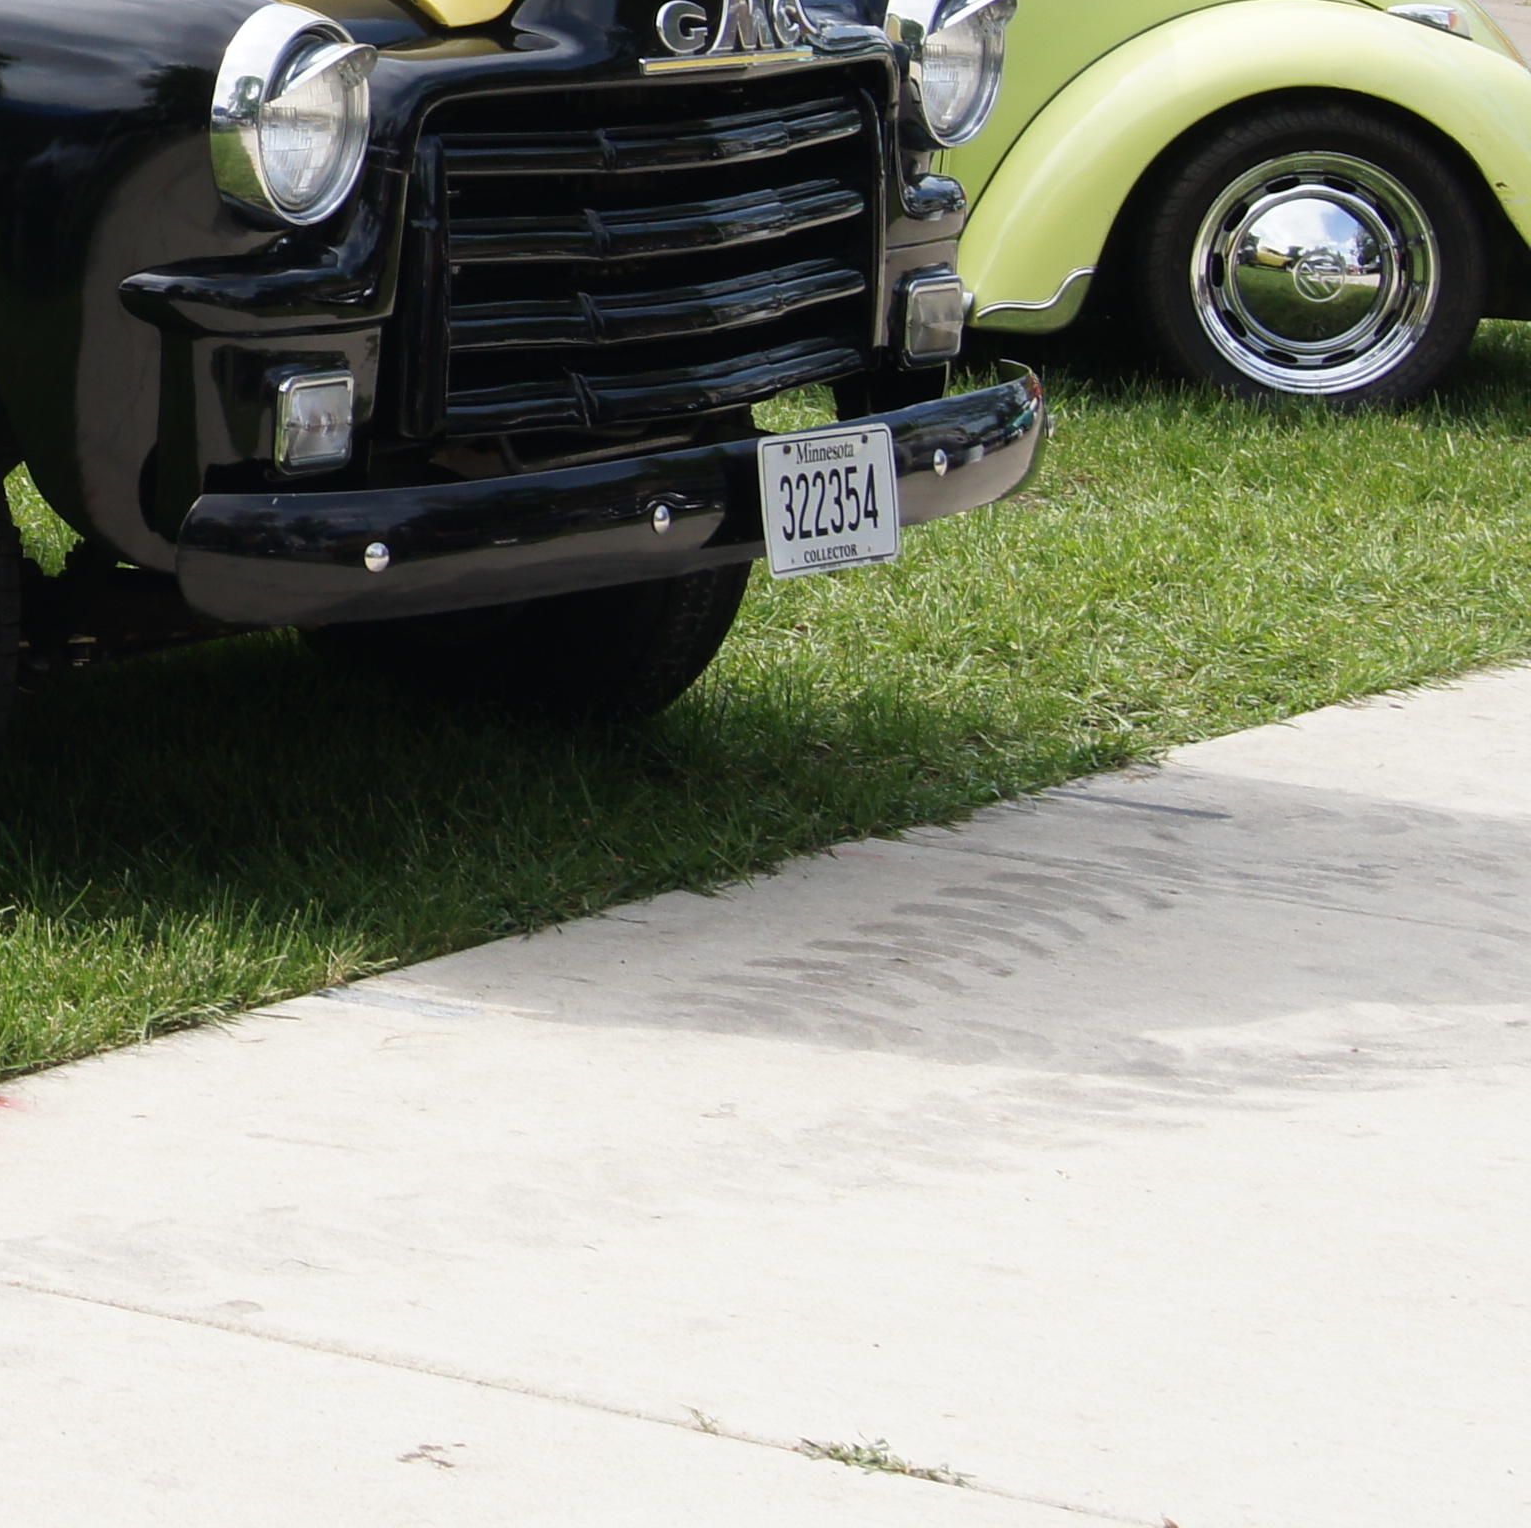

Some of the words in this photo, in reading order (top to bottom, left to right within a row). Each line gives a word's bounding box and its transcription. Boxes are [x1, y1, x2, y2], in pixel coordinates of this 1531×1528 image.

[796, 443, 855, 465] Minnesota
[779, 463, 879, 542] 322354
[804, 544, 858, 564] COLLECTOR
